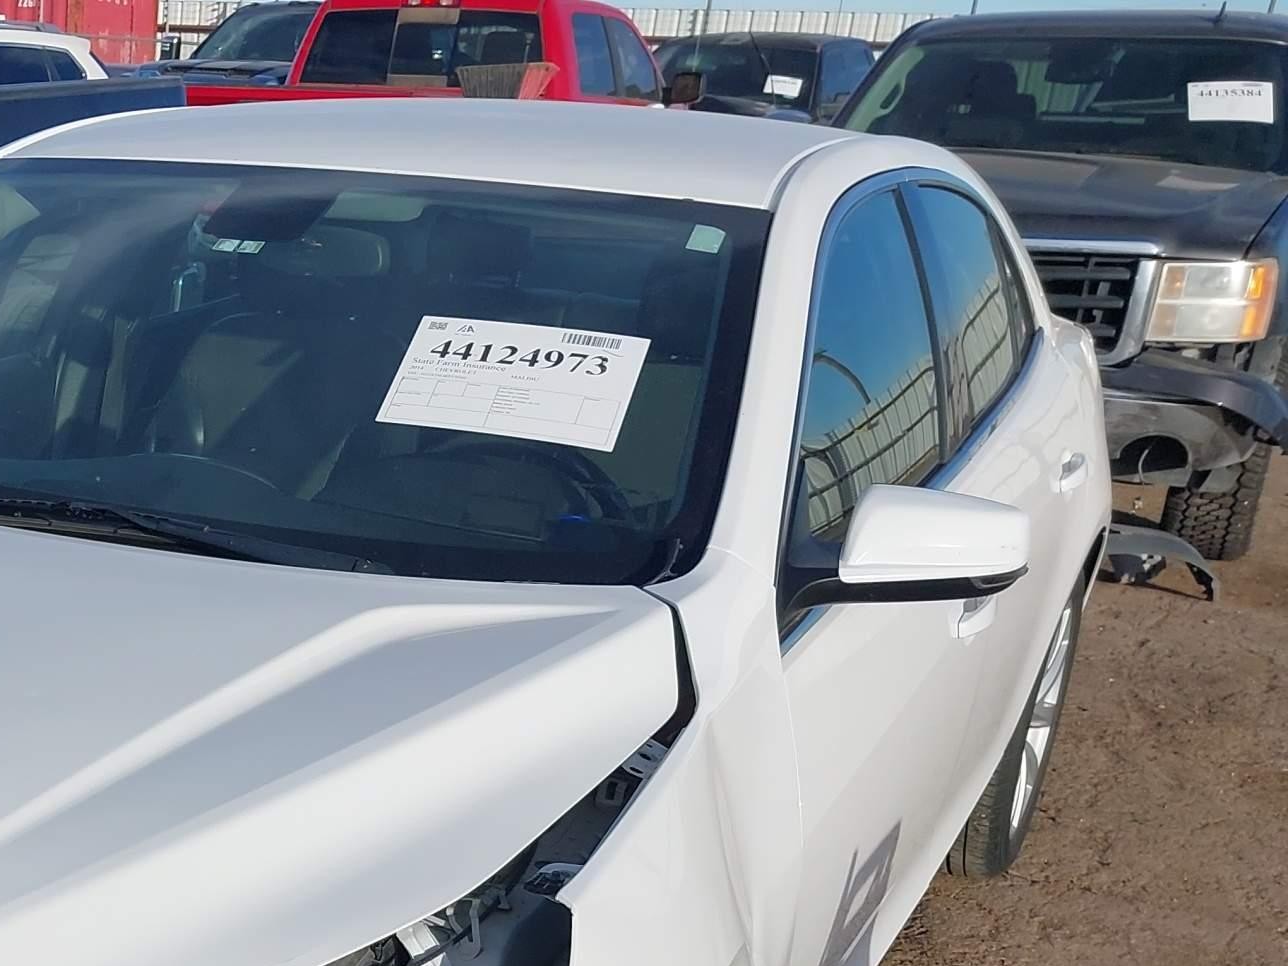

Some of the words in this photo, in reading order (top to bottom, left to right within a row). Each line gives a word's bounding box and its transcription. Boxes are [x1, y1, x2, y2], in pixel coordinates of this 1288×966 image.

[429, 339, 609, 376] 44124973
[437, 359, 461, 369] Farm
[463, 361, 508, 374] Insurance
